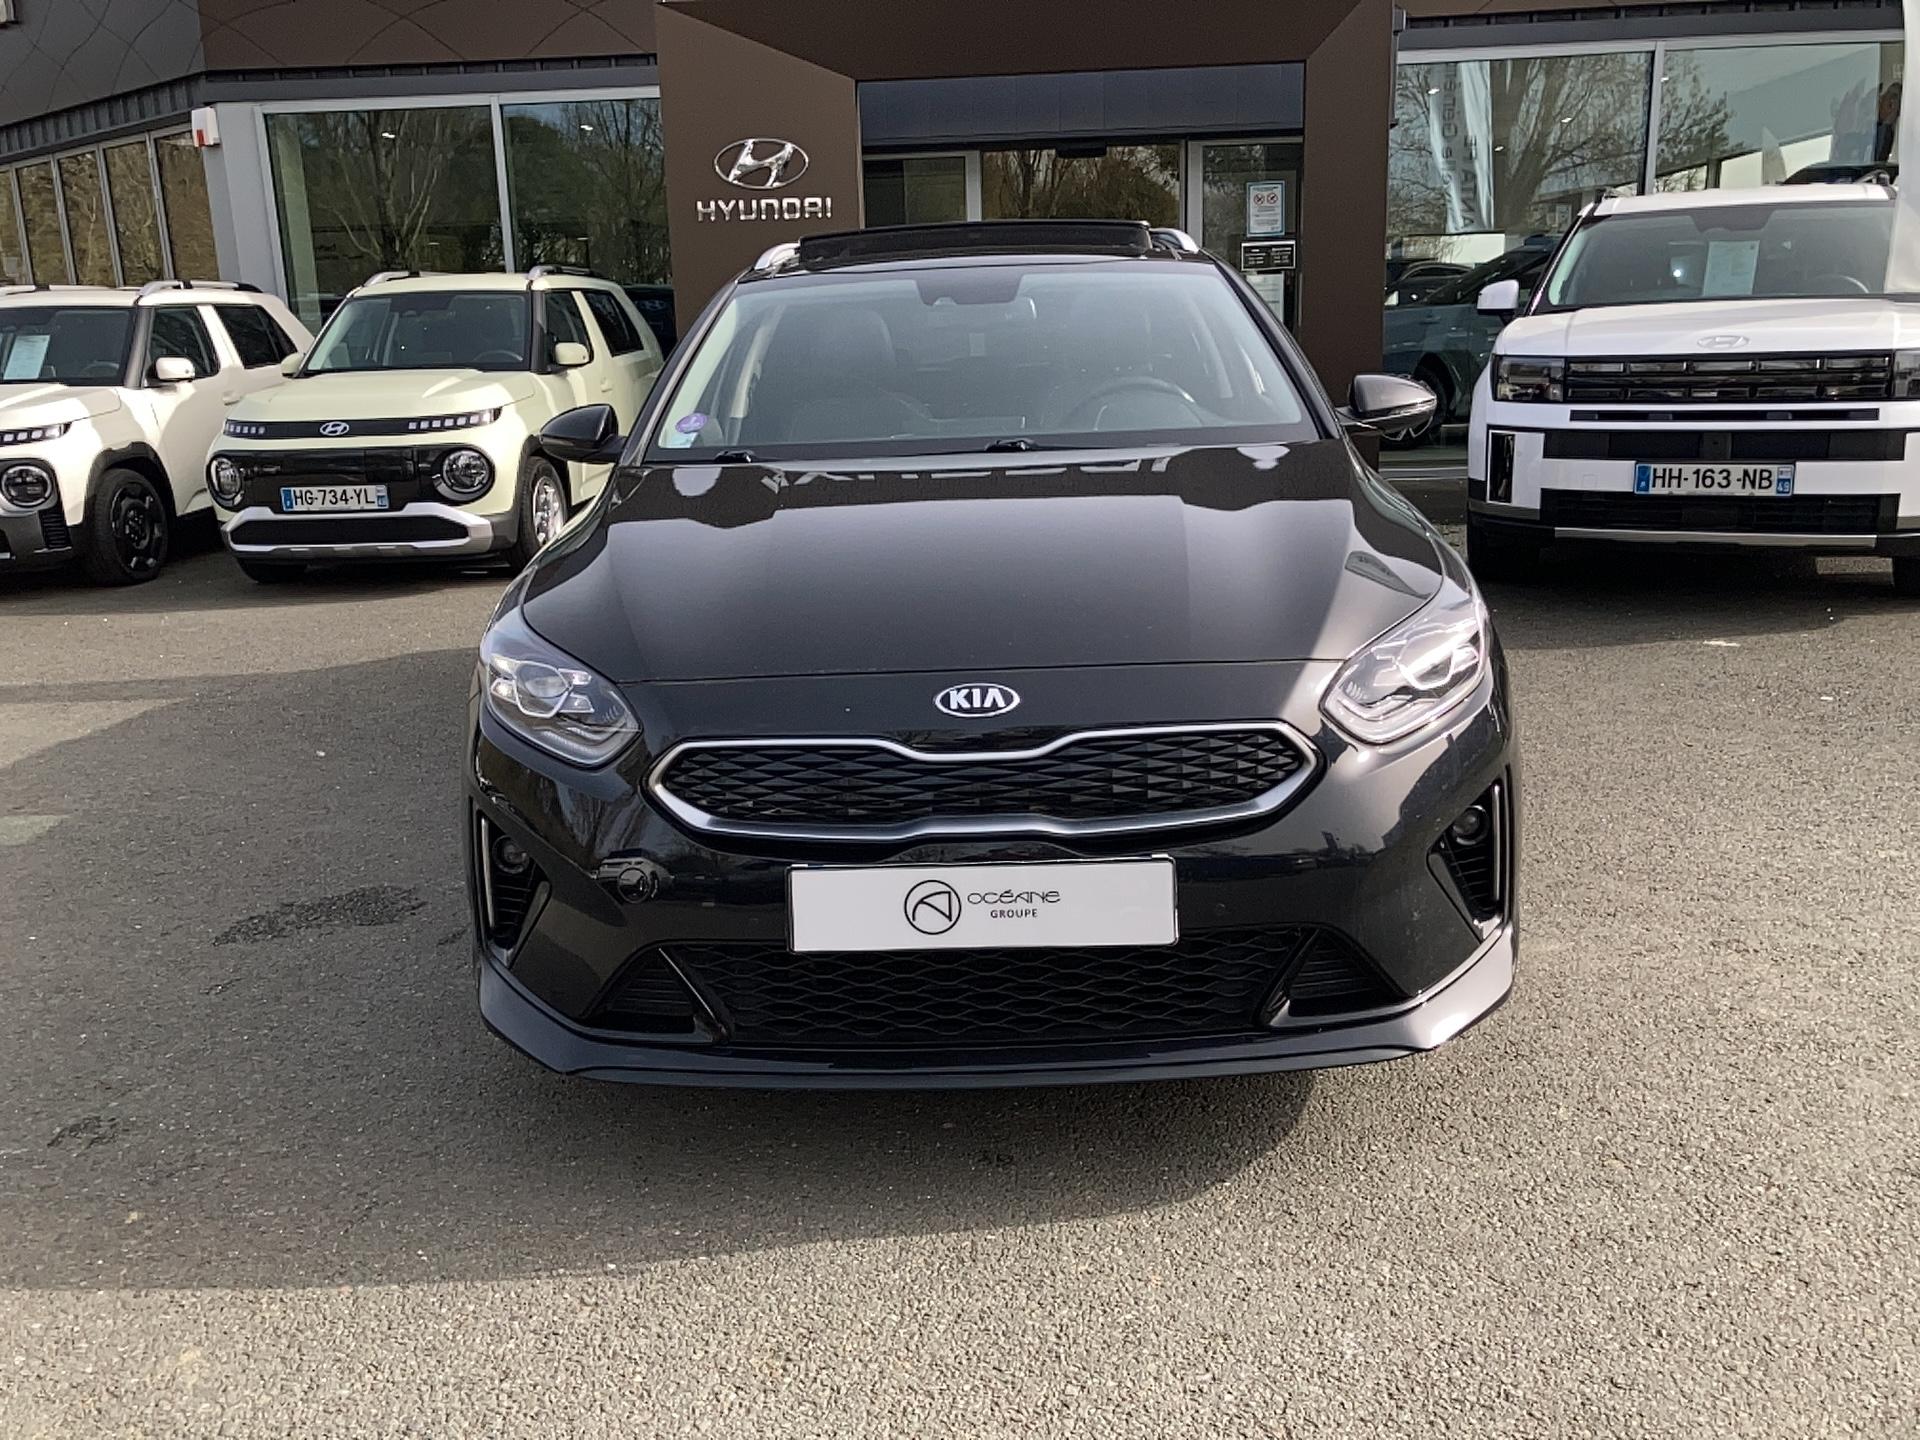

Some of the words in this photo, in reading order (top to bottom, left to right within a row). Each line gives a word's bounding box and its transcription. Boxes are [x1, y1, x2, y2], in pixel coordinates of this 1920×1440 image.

[697, 197, 832, 222] HYUNDAI
[1651, 468, 1774, 490] HH-163-NB
[293, 488, 376, 506] HG-734-YL
[949, 687, 1007, 710] KIA
[990, 908, 1039, 919] GROUPE
